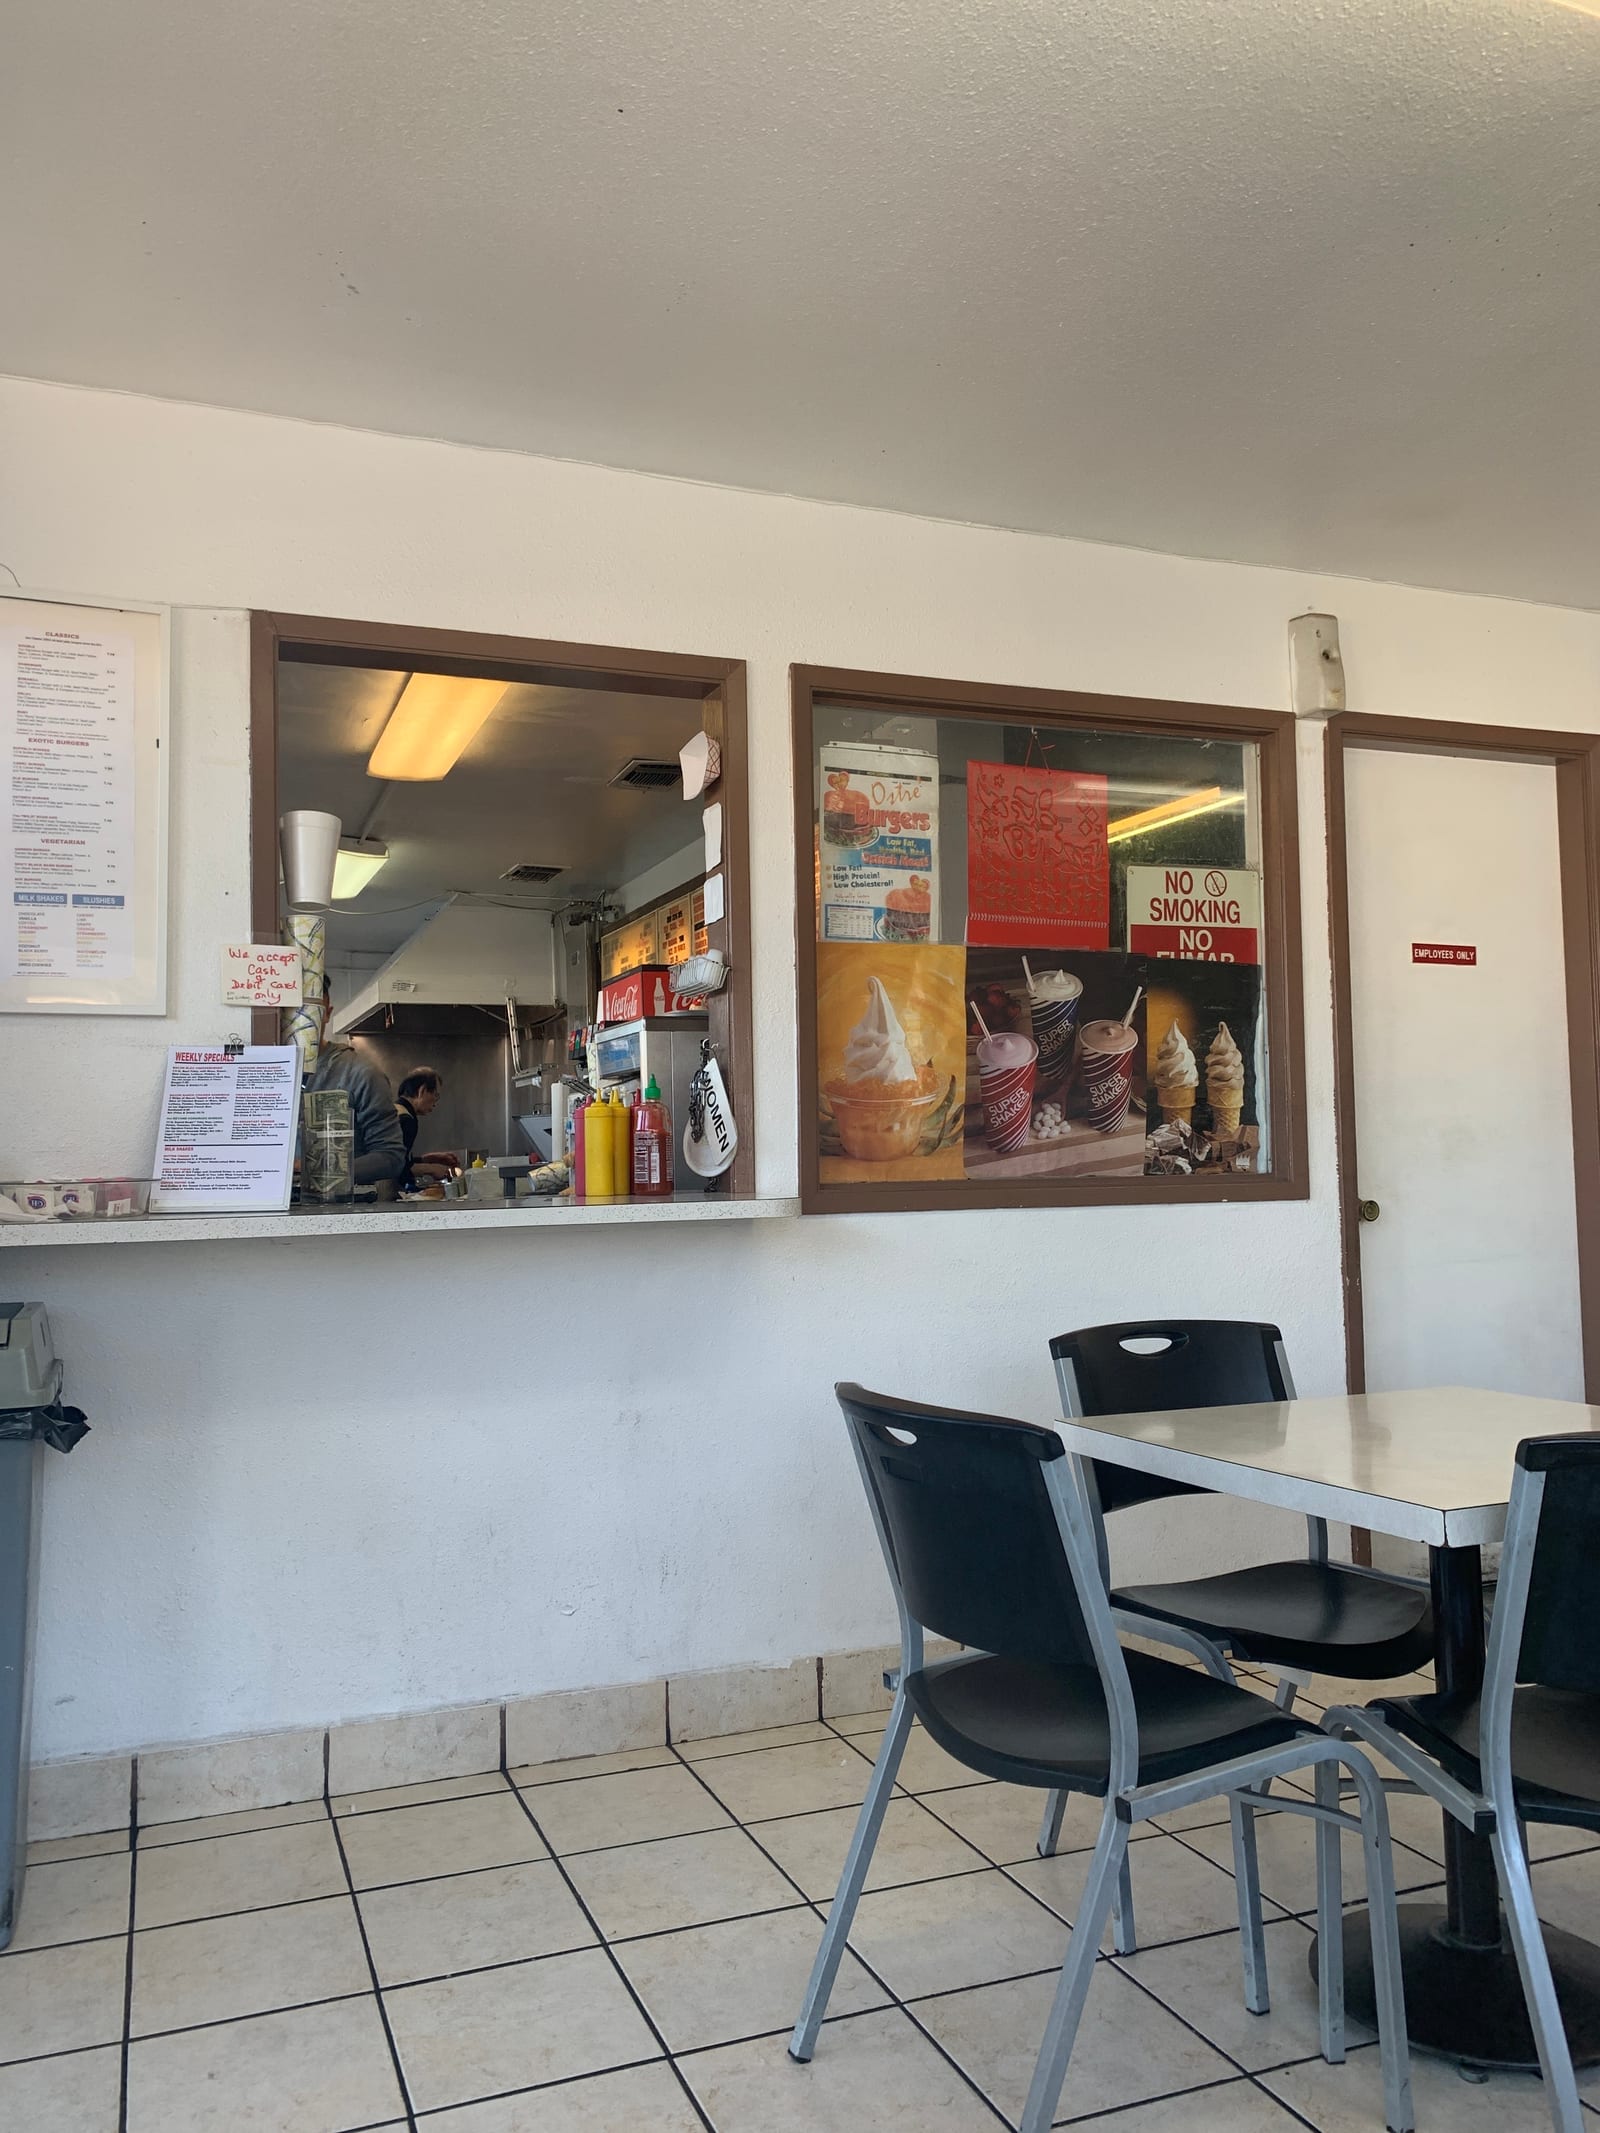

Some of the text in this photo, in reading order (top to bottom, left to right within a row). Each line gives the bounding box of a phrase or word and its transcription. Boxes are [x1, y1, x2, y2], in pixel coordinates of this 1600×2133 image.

[56, 739, 90, 747] BURGERS
[855, 801, 930, 834] Burgers
[886, 838, 902, 847] Low
[833, 872, 880, 881] High Protein!
[851, 880, 894, 889] Cholesterol!
[1165, 870, 1194, 895] NO
[36, 895, 65, 903] SHAKES
[82, 896, 115, 904] SLUSHIES
[1150, 897, 1241, 924] SMOKING
[1179, 929, 1213, 951] NO
[229, 948, 298, 966] We accept
[1414, 948, 1475, 961] EMPLOYEES ONLY
[247, 964, 280, 976] Cash
[255, 989, 281, 1005] only
[1038, 1019, 1071, 1044] SUPER
[1040, 1024, 1075, 1056] SHAKES
[175, 1052, 235, 1062] WEEKLY SPECIALS
[1089, 1072, 1126, 1098] SUPER
[1091, 1078, 1128, 1108] SHAKES
[988, 1086, 1026, 1117] SUPER
[989, 1092, 1030, 1128] SHAKES
